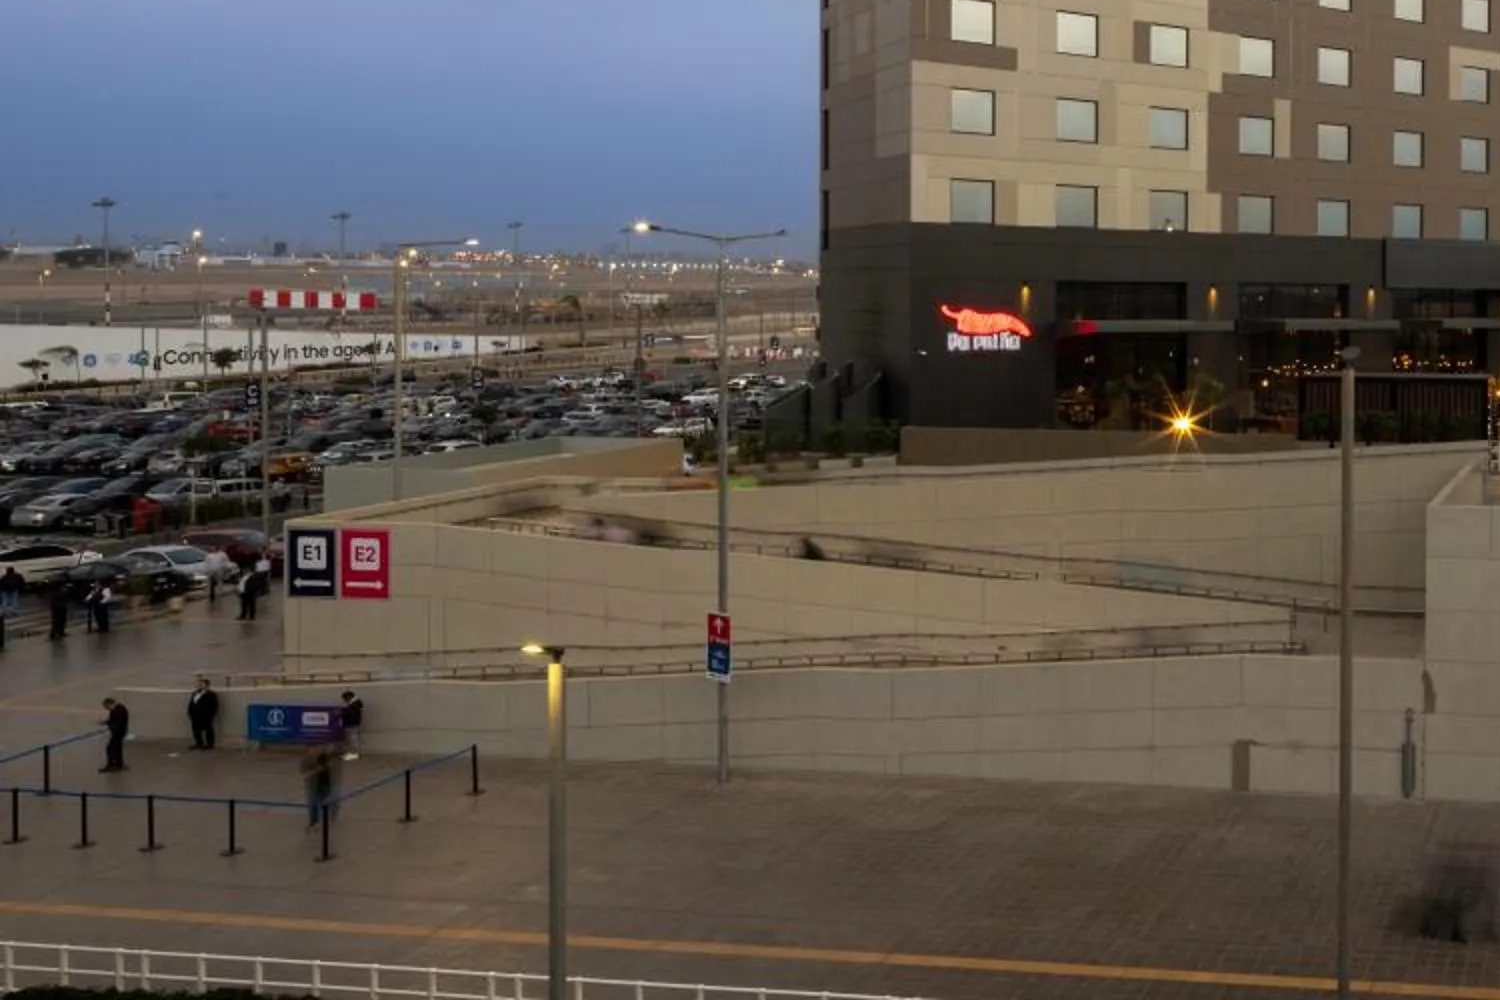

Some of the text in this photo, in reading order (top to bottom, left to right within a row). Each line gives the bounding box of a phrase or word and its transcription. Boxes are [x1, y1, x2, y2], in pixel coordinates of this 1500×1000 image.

[163, 344, 279, 366] Conntivity
[302, 344, 329, 359] the
[333, 345, 362, 361] age
[303, 545, 321, 561] E1
[355, 546, 376, 563] E2
